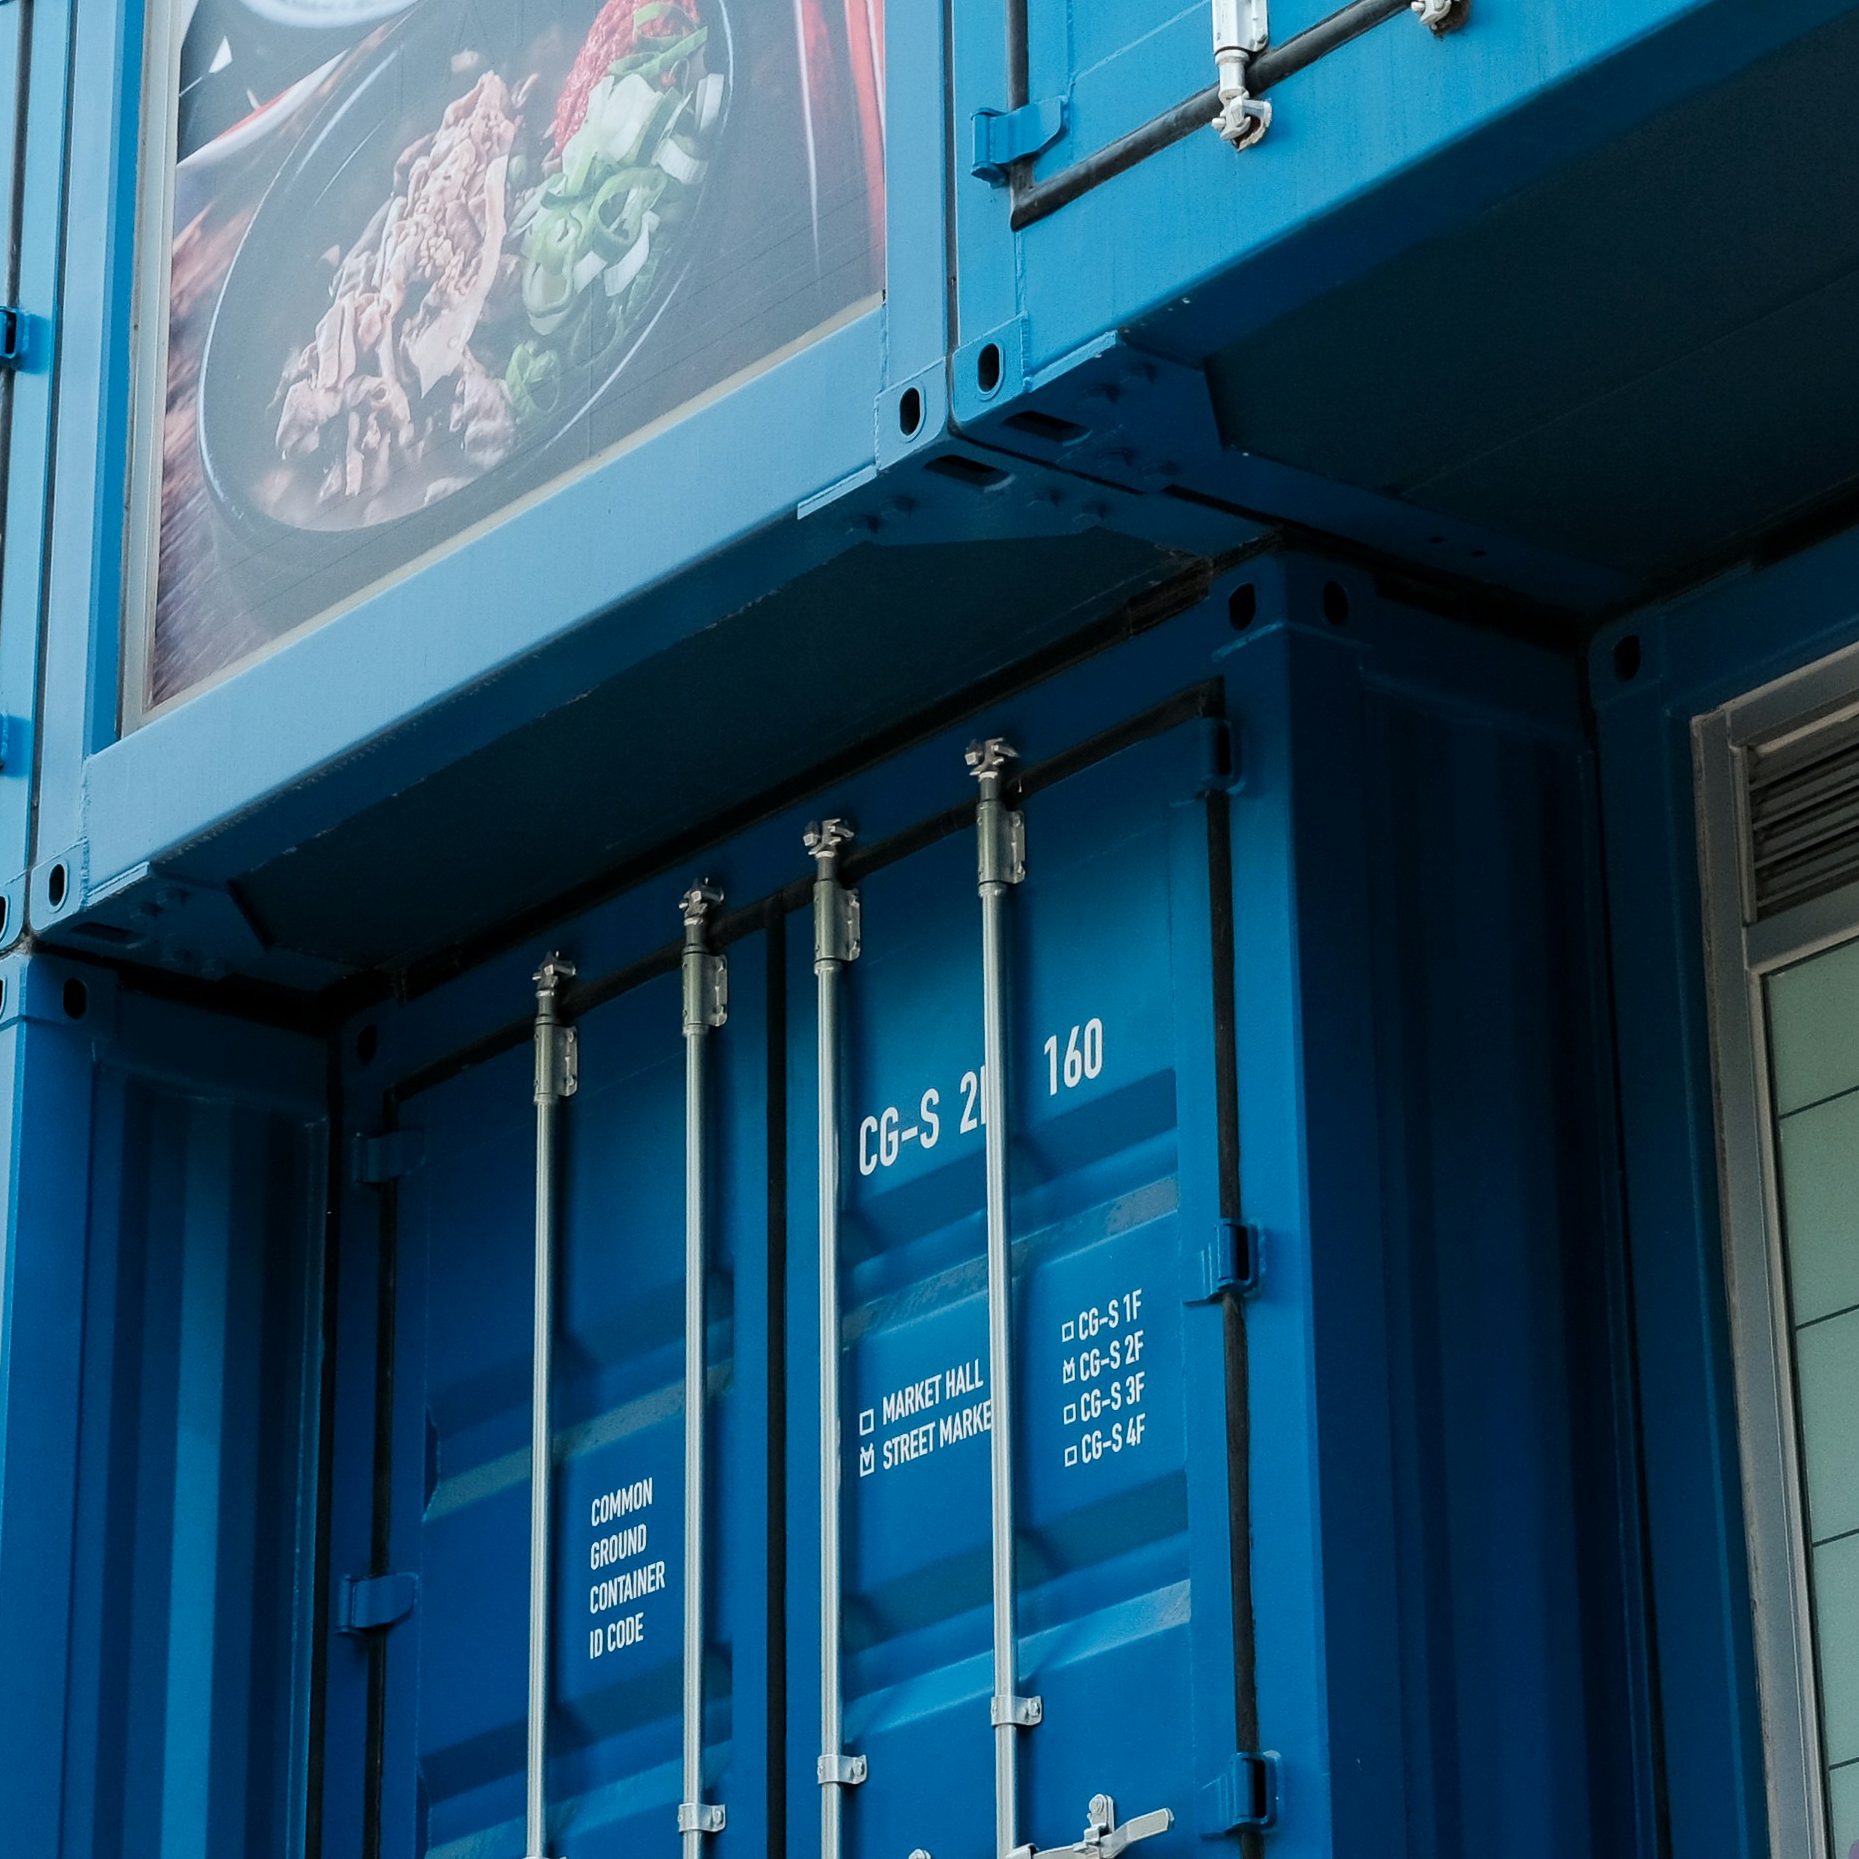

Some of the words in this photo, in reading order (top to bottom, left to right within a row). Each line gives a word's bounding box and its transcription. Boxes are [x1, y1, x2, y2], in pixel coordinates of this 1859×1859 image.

[859, 1087, 940, 1176] CG-S
[1043, 1017, 1104, 1096] 160
[1078, 1299, 1119, 1341] CG-S
[1122, 1288, 1142, 1323] 1F
[1079, 1340, 1121, 1382] CG-S
[1124, 1329, 1144, 1366] 2F
[883, 1373, 942, 1426] MARKET
[945, 1358, 984, 1400] HALL
[1080, 1381, 1122, 1423] CG-S
[1125, 1371, 1145, 1406] 3F
[883, 1421, 936, 1470] STREET
[939, 1398, 992, 1449] MARKE
[1081, 1422, 1123, 1464] CG-S
[1126, 1412, 1146, 1447] 4F
[591, 1477, 653, 1527] COMMON
[590, 1523, 647, 1571] GROUND
[589, 1560, 666, 1615] CONTAINER
[589, 1628, 604, 1660] ID
[607, 1611, 645, 1653] CODE
